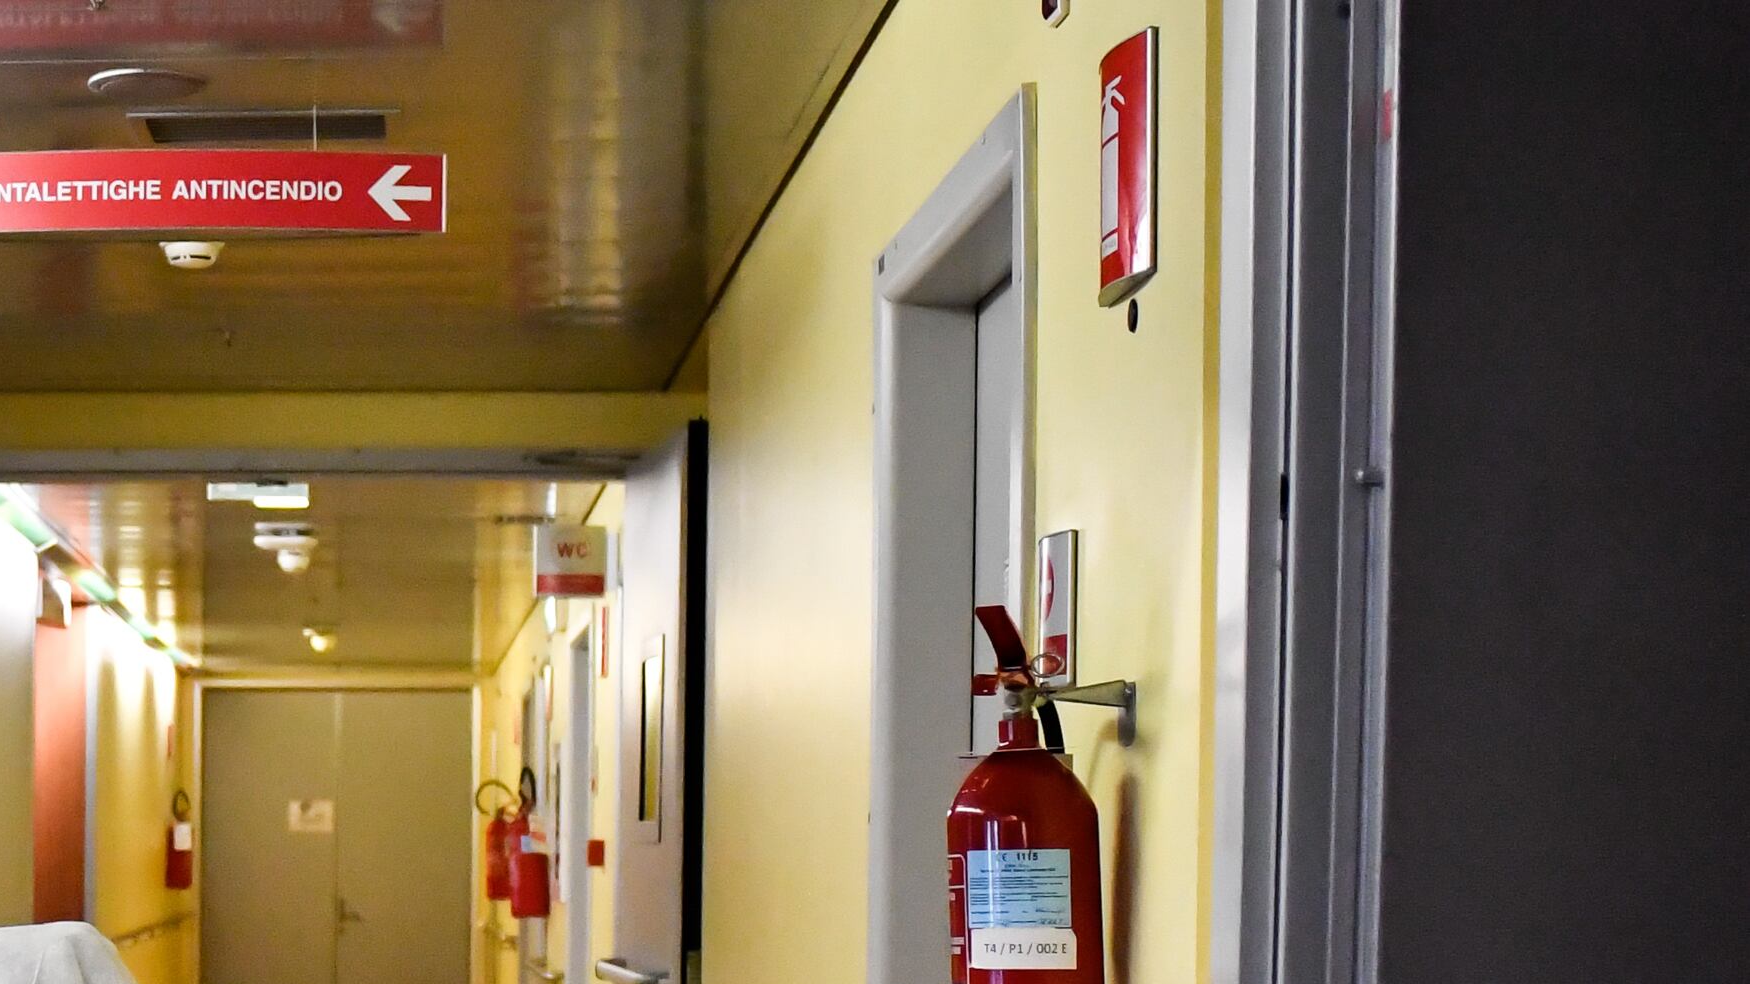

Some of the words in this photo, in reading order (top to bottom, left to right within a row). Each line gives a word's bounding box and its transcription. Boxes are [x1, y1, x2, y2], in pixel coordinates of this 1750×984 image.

[171, 179, 343, 202] ANTINCENDIO
[557, 542, 587, 559] WC
[984, 943, 997, 954] T4
[1009, 943, 1023, 954] P1
[1036, 943, 1058, 954] 002
[1061, 943, 1067, 954] E
